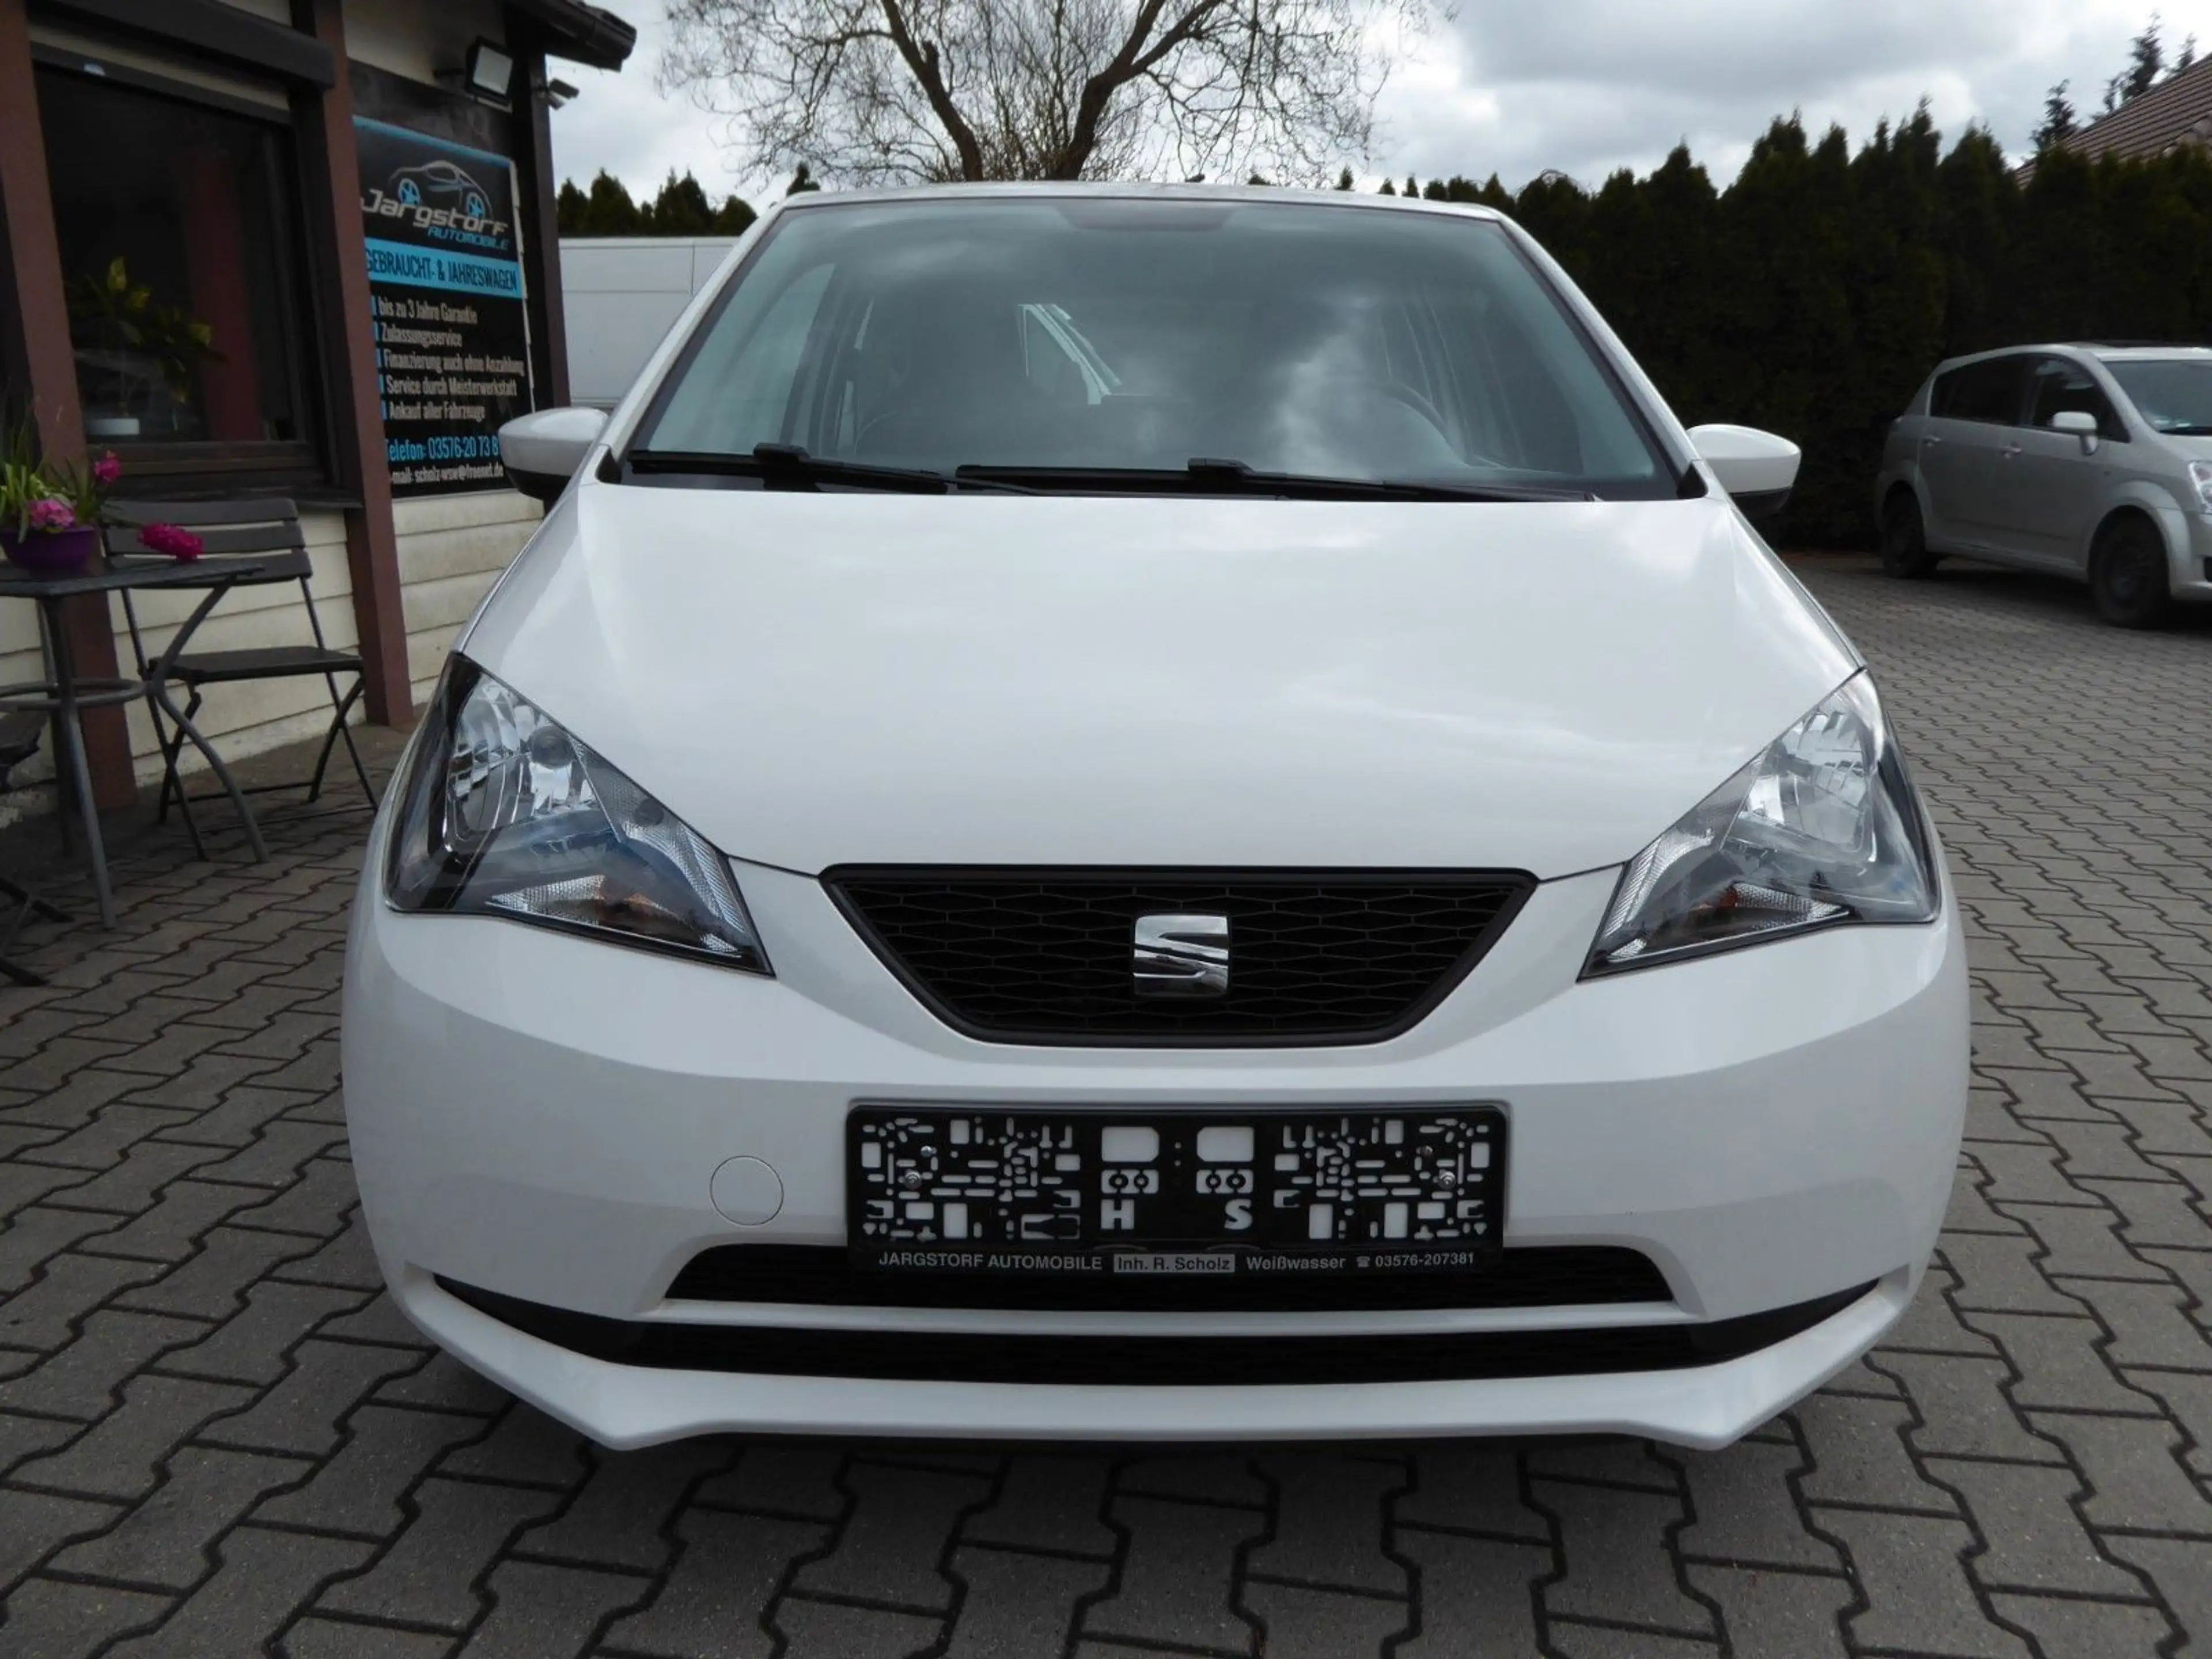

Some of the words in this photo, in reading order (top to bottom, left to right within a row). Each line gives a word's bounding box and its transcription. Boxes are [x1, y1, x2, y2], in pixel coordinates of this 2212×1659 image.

[428, 226, 510, 251] AUTOMOBILE
[437, 257, 446, 282] &
[448, 258, 517, 291] JAHRESWAGEN
[378, 296, 393, 318] bis
[407, 298, 415, 319] 3
[415, 301, 440, 321] Jahre
[441, 302, 478, 324] Garantie
[381, 321, 463, 348] Zulassungsservice
[384, 348, 442, 374] Finanzierung
[387, 375, 421, 395] Service
[422, 376, 447, 395] durch
[448, 377, 517, 396] Meisterwerkstatt
[389, 401, 421, 420] Ankauf
[444, 401, 486, 422] Fahrzeuge
[492, 435, 499, 456] 8
[879, 1252, 984, 1268] JARGSTORF
[987, 1253, 1103, 1271] AUTOMOBILE
[1118, 1256, 1147, 1271] Inh.
[1174, 1255, 1230, 1271] Scholz
[1246, 1255, 1347, 1271] Weißwasser
[1374, 1252, 1475, 1268] 03576-207381
